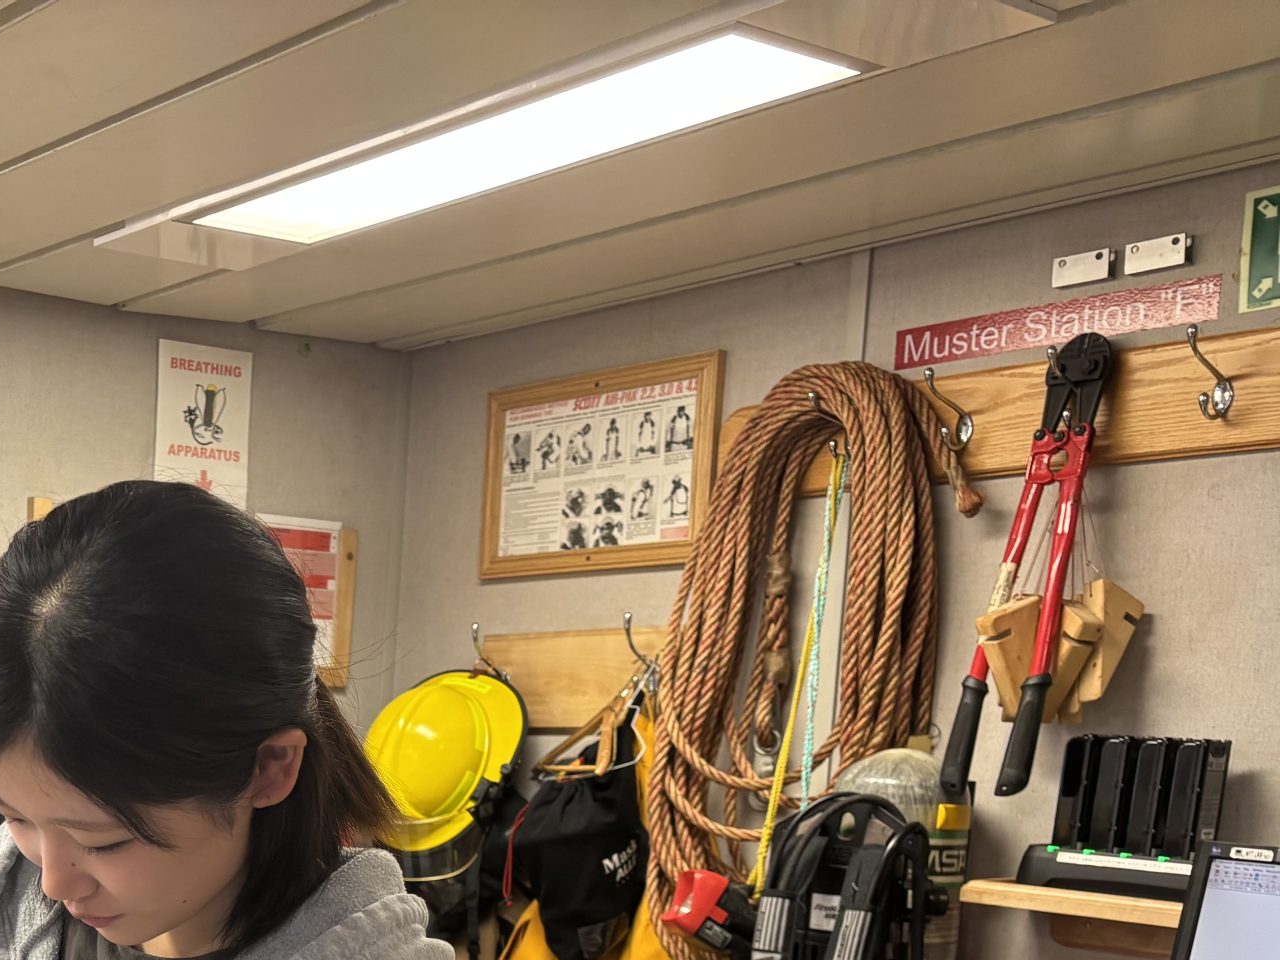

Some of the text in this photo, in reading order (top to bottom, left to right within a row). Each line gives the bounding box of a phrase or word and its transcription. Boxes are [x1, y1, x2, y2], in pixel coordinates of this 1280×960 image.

[903, 282, 1216, 364] Muster Station "F"
[170, 356, 242, 378] BREATHING
[168, 443, 241, 462] APPARATUS
